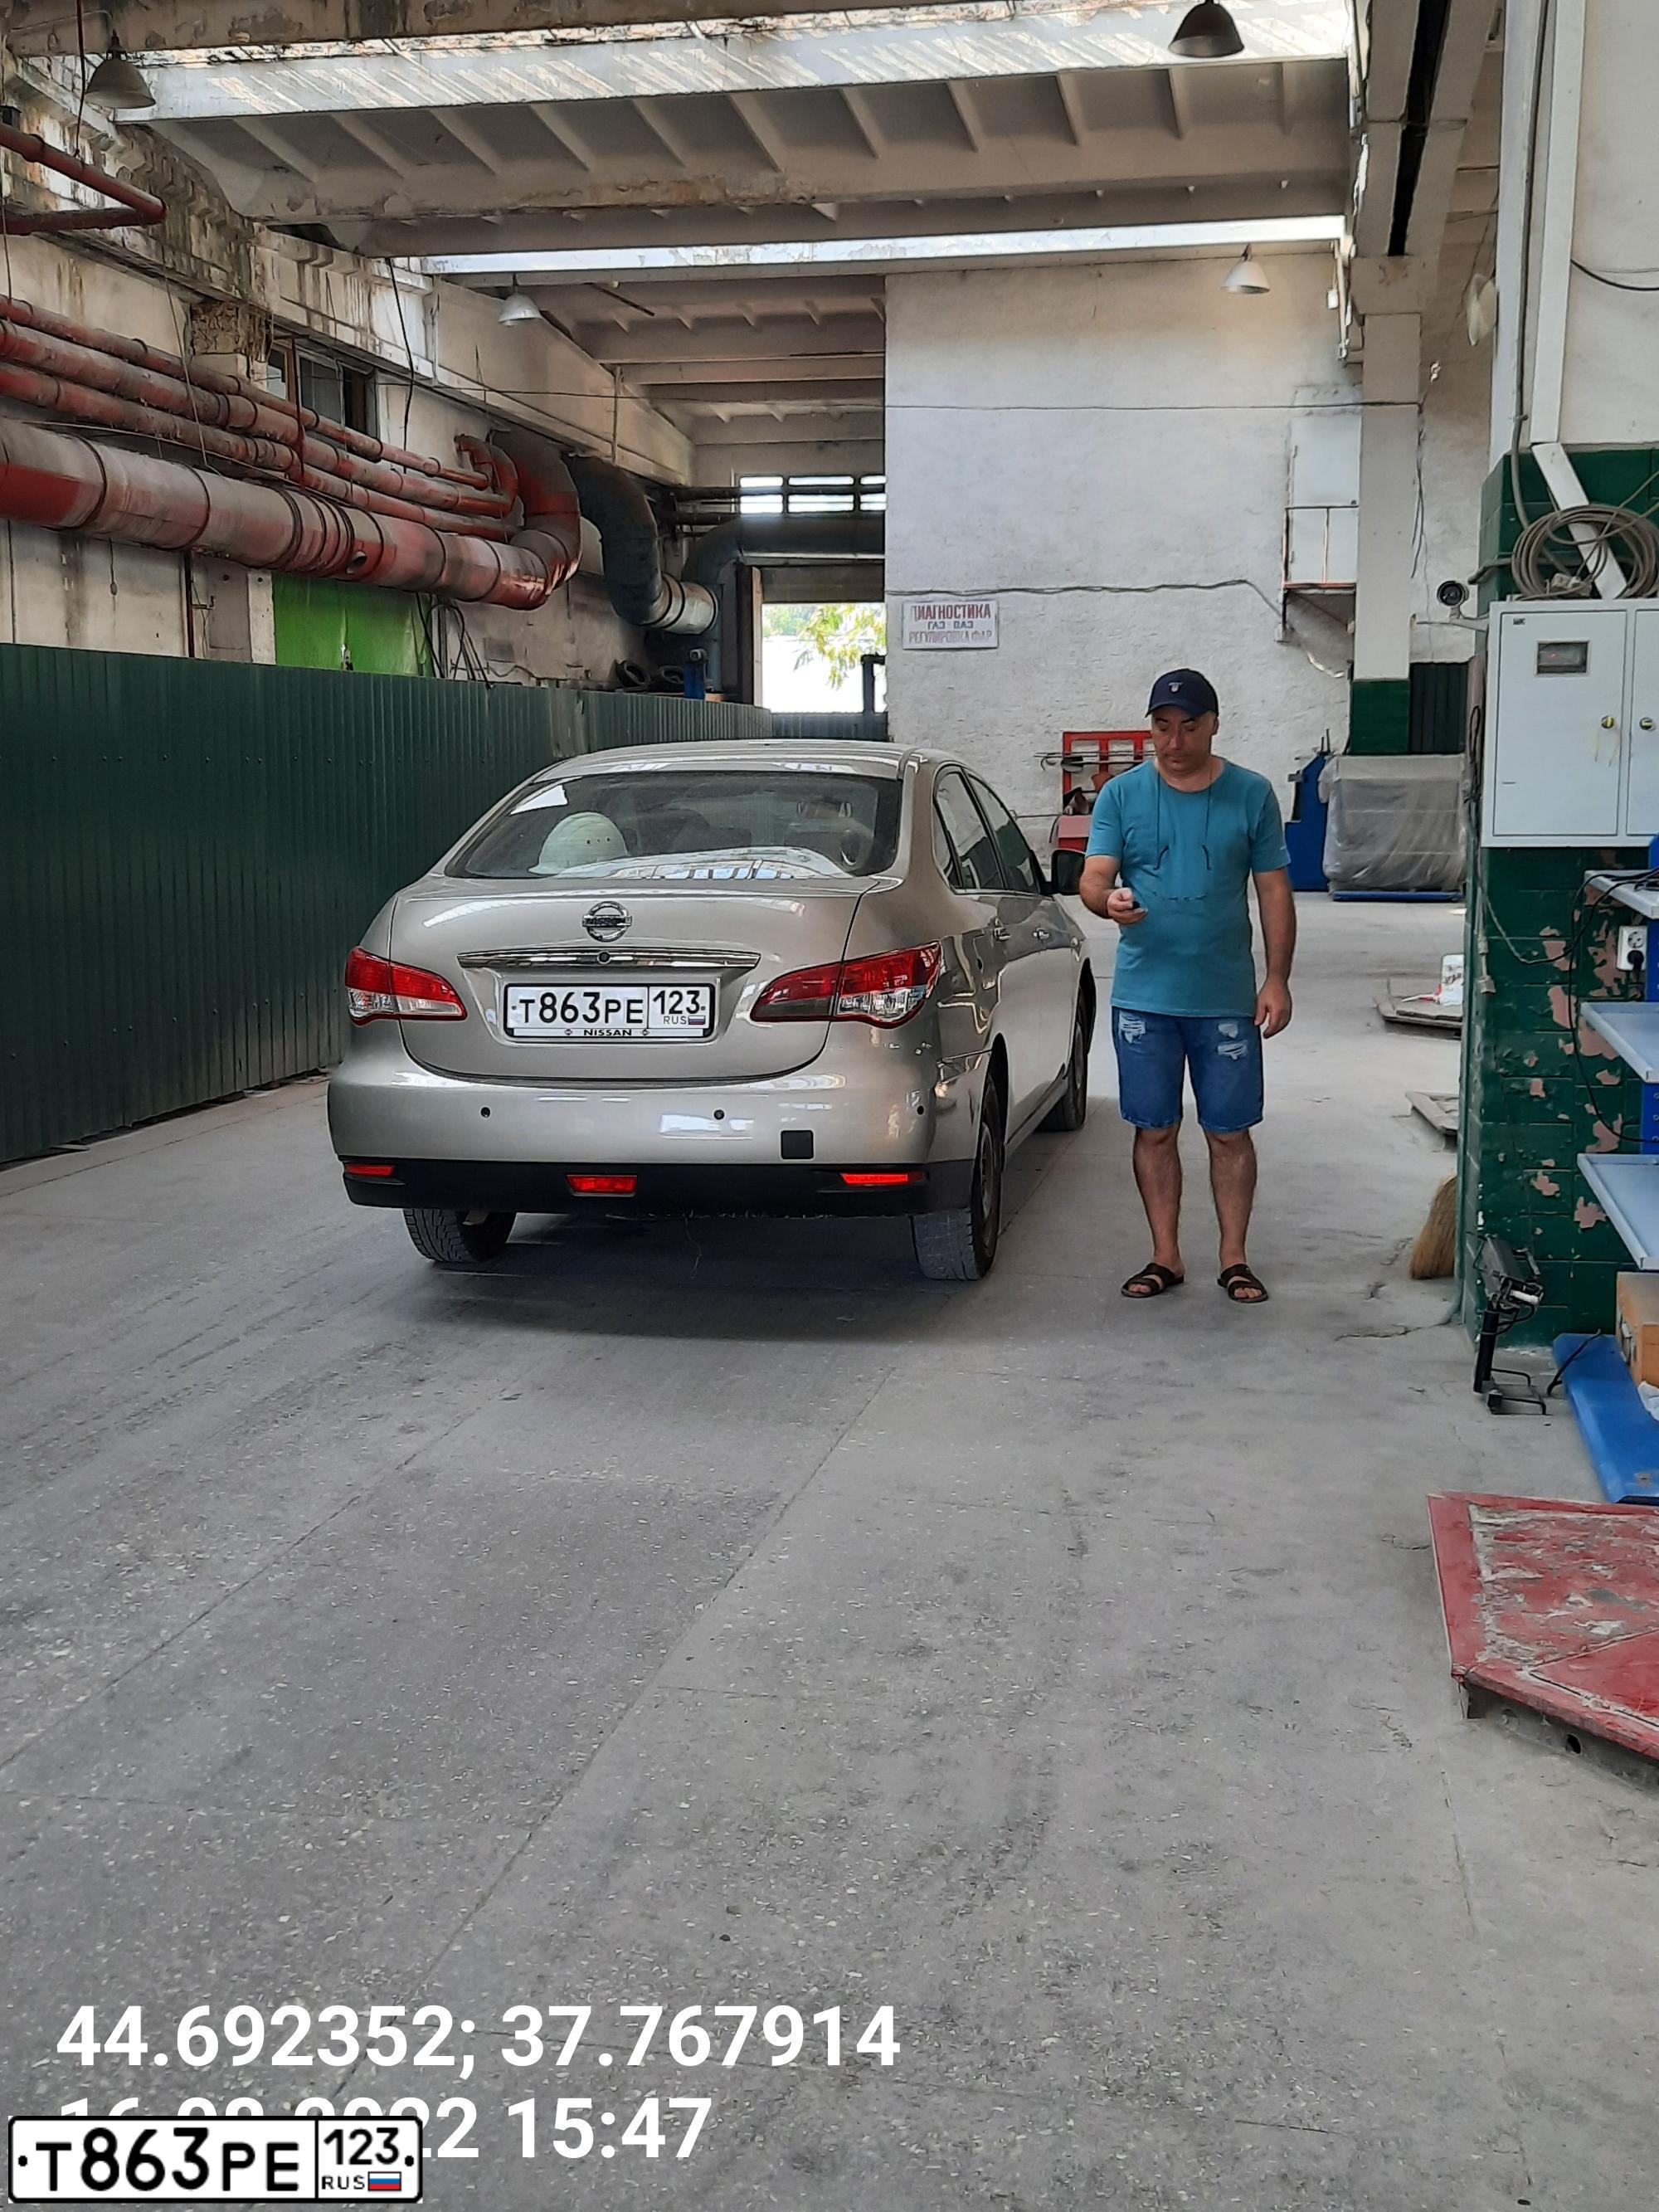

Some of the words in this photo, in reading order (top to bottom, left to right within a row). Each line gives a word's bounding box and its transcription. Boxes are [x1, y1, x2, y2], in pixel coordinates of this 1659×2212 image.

[927, 621, 946, 630] ГАЗ
[653, 990, 700, 1015] 123
[664, 1016, 687, 1025] RUS
